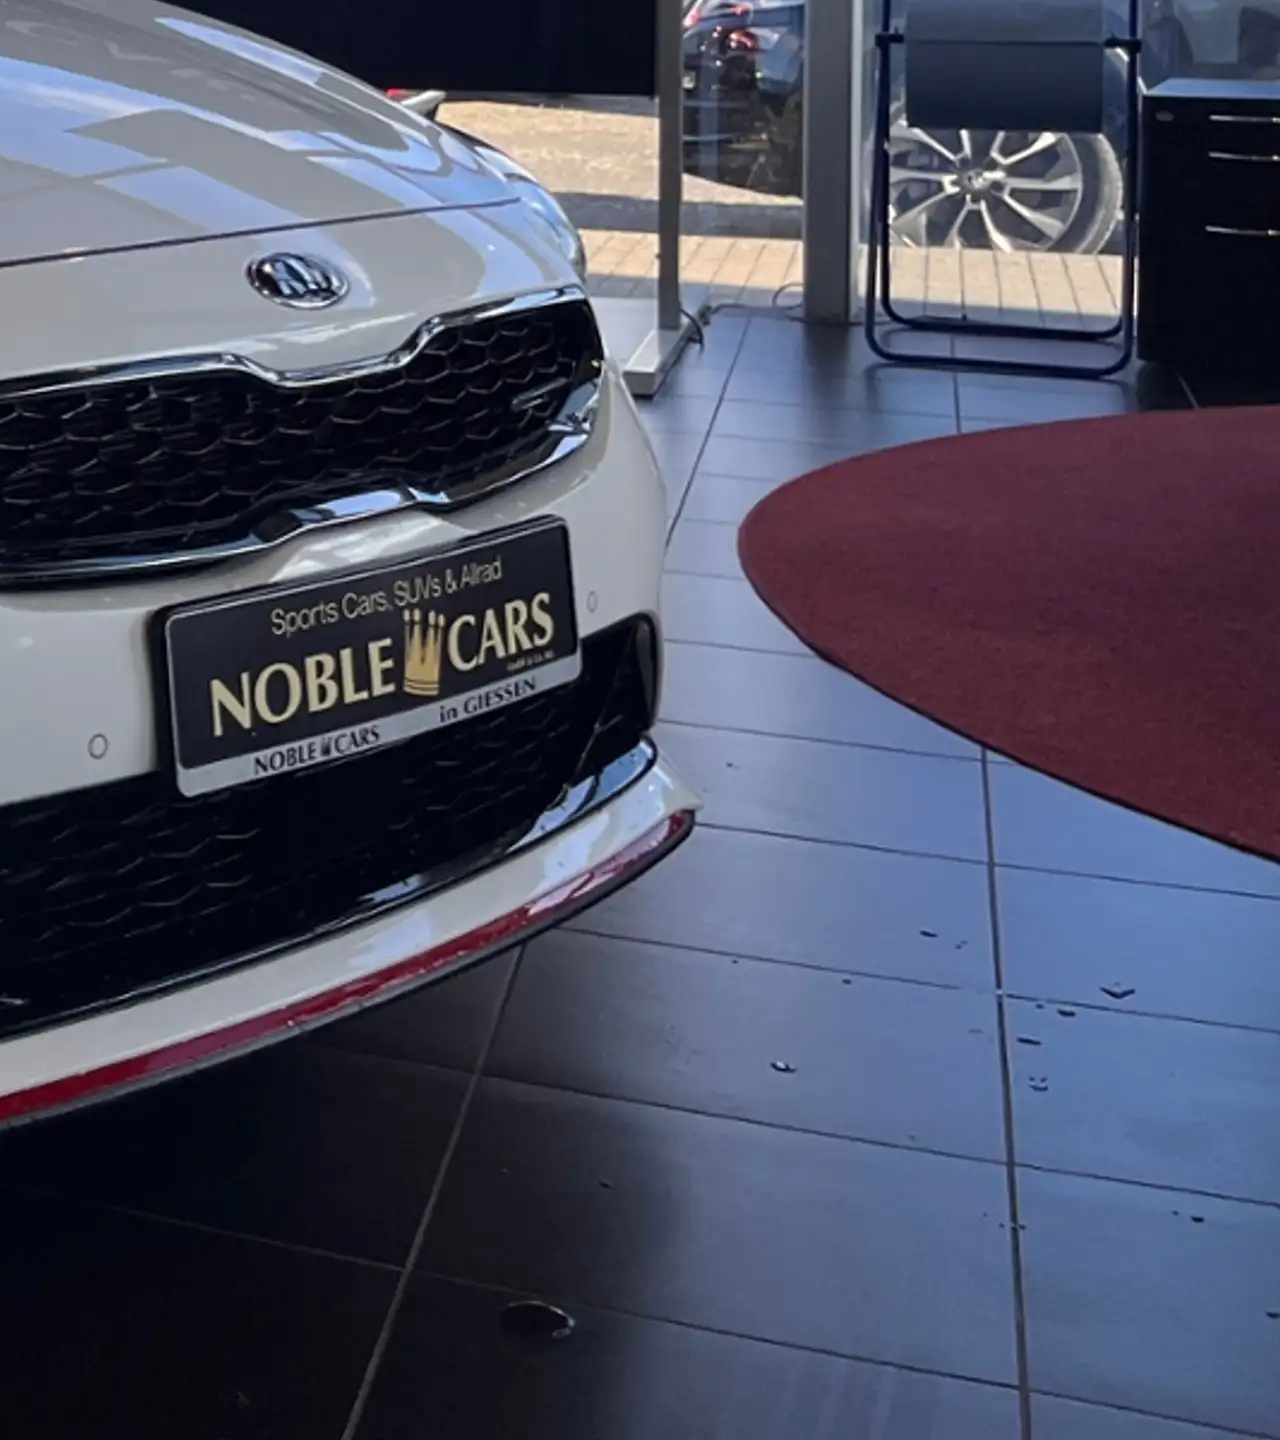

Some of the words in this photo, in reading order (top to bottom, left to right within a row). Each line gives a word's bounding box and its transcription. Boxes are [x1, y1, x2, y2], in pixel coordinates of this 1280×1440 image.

[270, 601, 340, 638] Sports
[393, 574, 441, 607] SUVs
[444, 568, 459, 595] &
[460, 555, 503, 589] Allrad
[210, 637, 396, 738] NOBLE
[447, 591, 555, 672] CARS
[253, 741, 317, 776] NOBLE
[333, 724, 381, 757] CARS
[439, 705, 458, 723] in
[463, 676, 537, 715] GIESSEN
